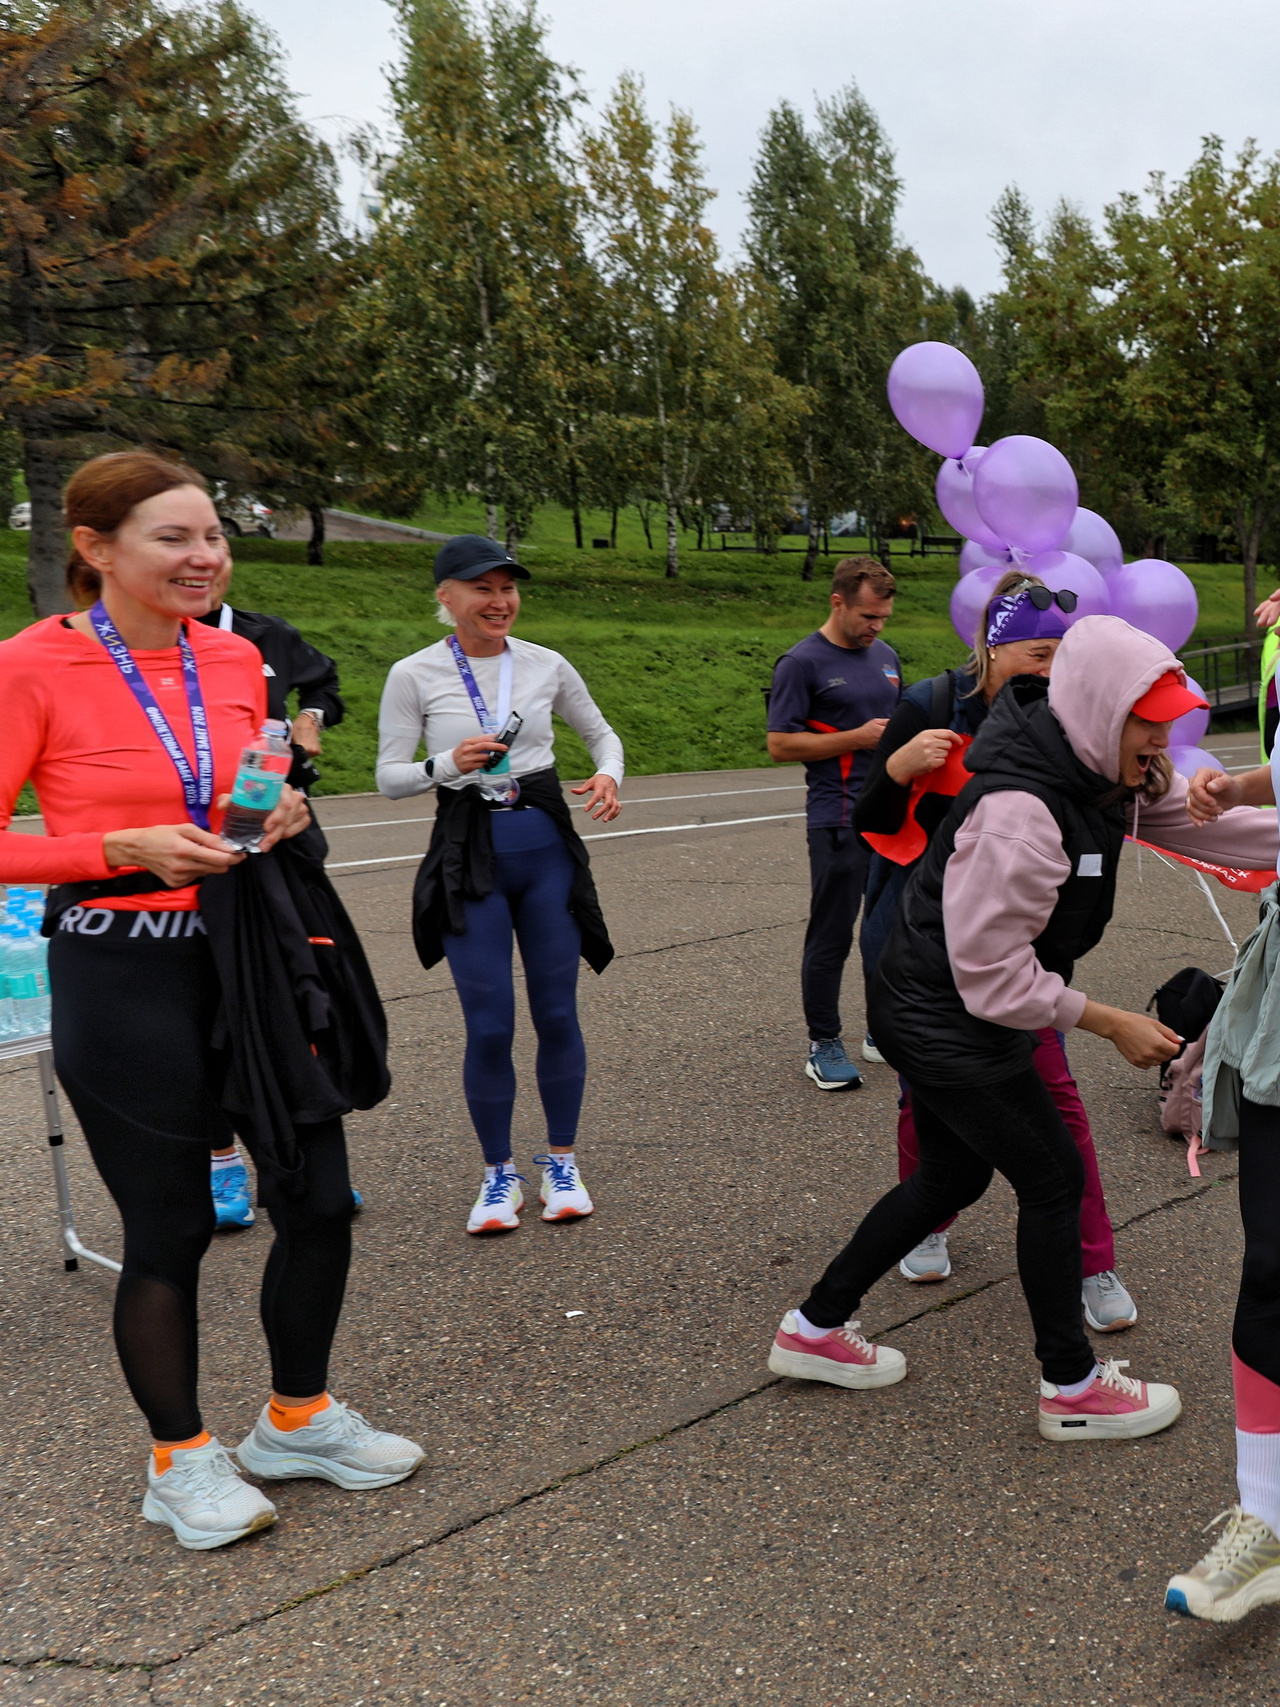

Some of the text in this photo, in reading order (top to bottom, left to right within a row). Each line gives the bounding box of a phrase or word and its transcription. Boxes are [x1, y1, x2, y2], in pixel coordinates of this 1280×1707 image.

[95, 620, 136, 674] ЖИЗНЬ
[194, 727, 210, 750] ЗАБЕГ
[198, 750, 213, 805] ФИОЛЕТОВЫЙ
[59, 905, 115, 935] RO
